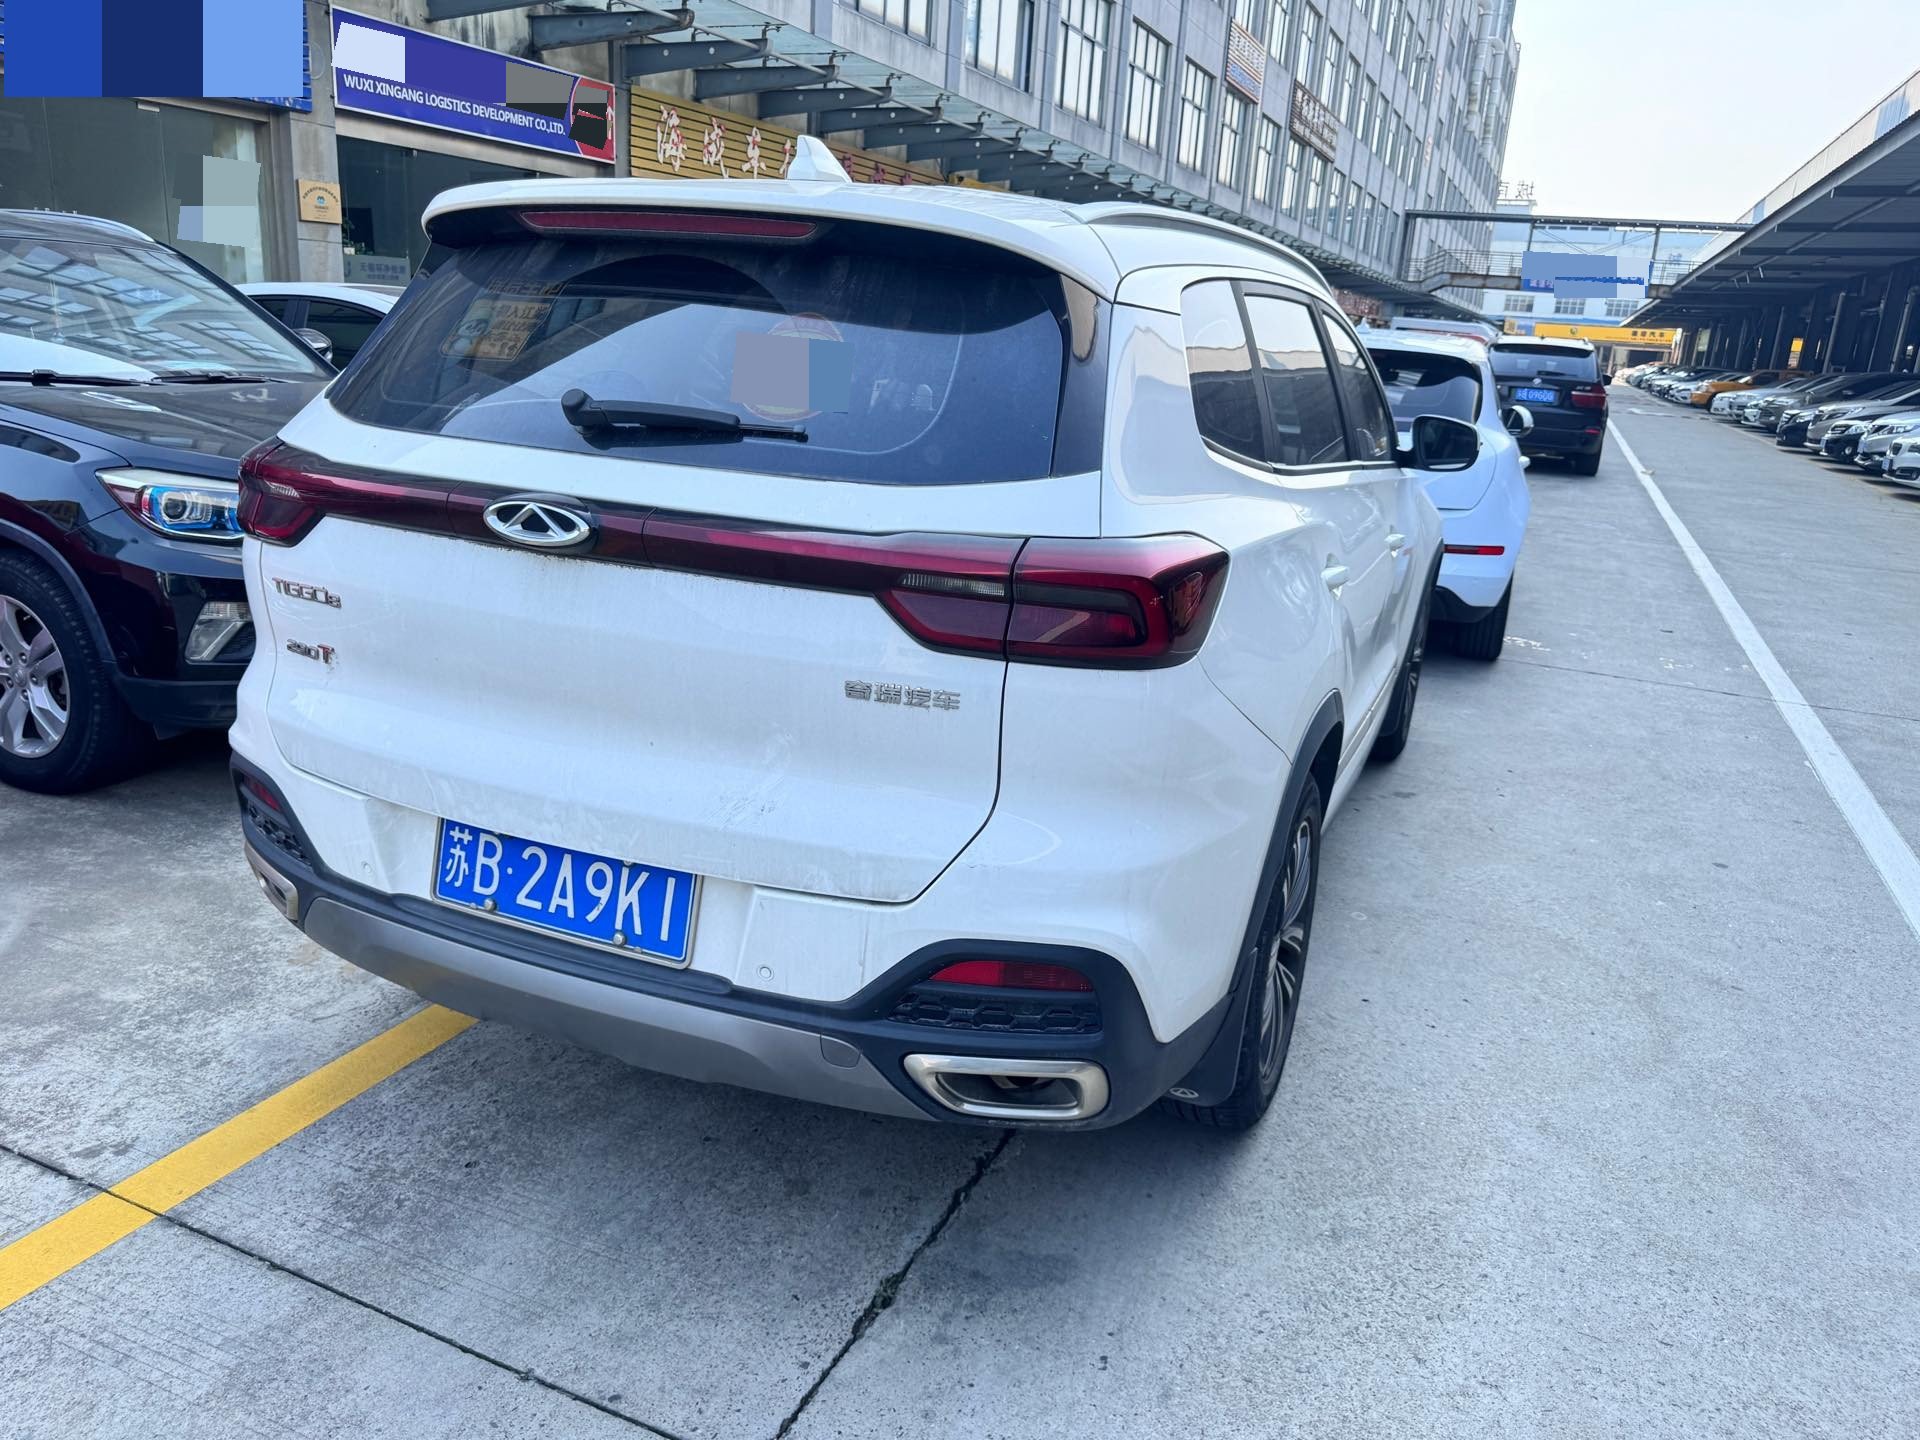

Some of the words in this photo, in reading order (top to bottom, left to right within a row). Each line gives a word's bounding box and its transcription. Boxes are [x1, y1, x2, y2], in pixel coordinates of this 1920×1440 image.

[343, 74, 374, 93] WUXI
[375, 81, 424, 104] XINGANG
[425, 92, 471, 115] LOGISTICS
[473, 104, 534, 129] DEVELOPMENT
[535, 118, 566, 136] CO.,LTD.
[844, 679, 961, 710] 奇瑞汽车
[445, 826, 676, 942] 苏B·2A9K1
